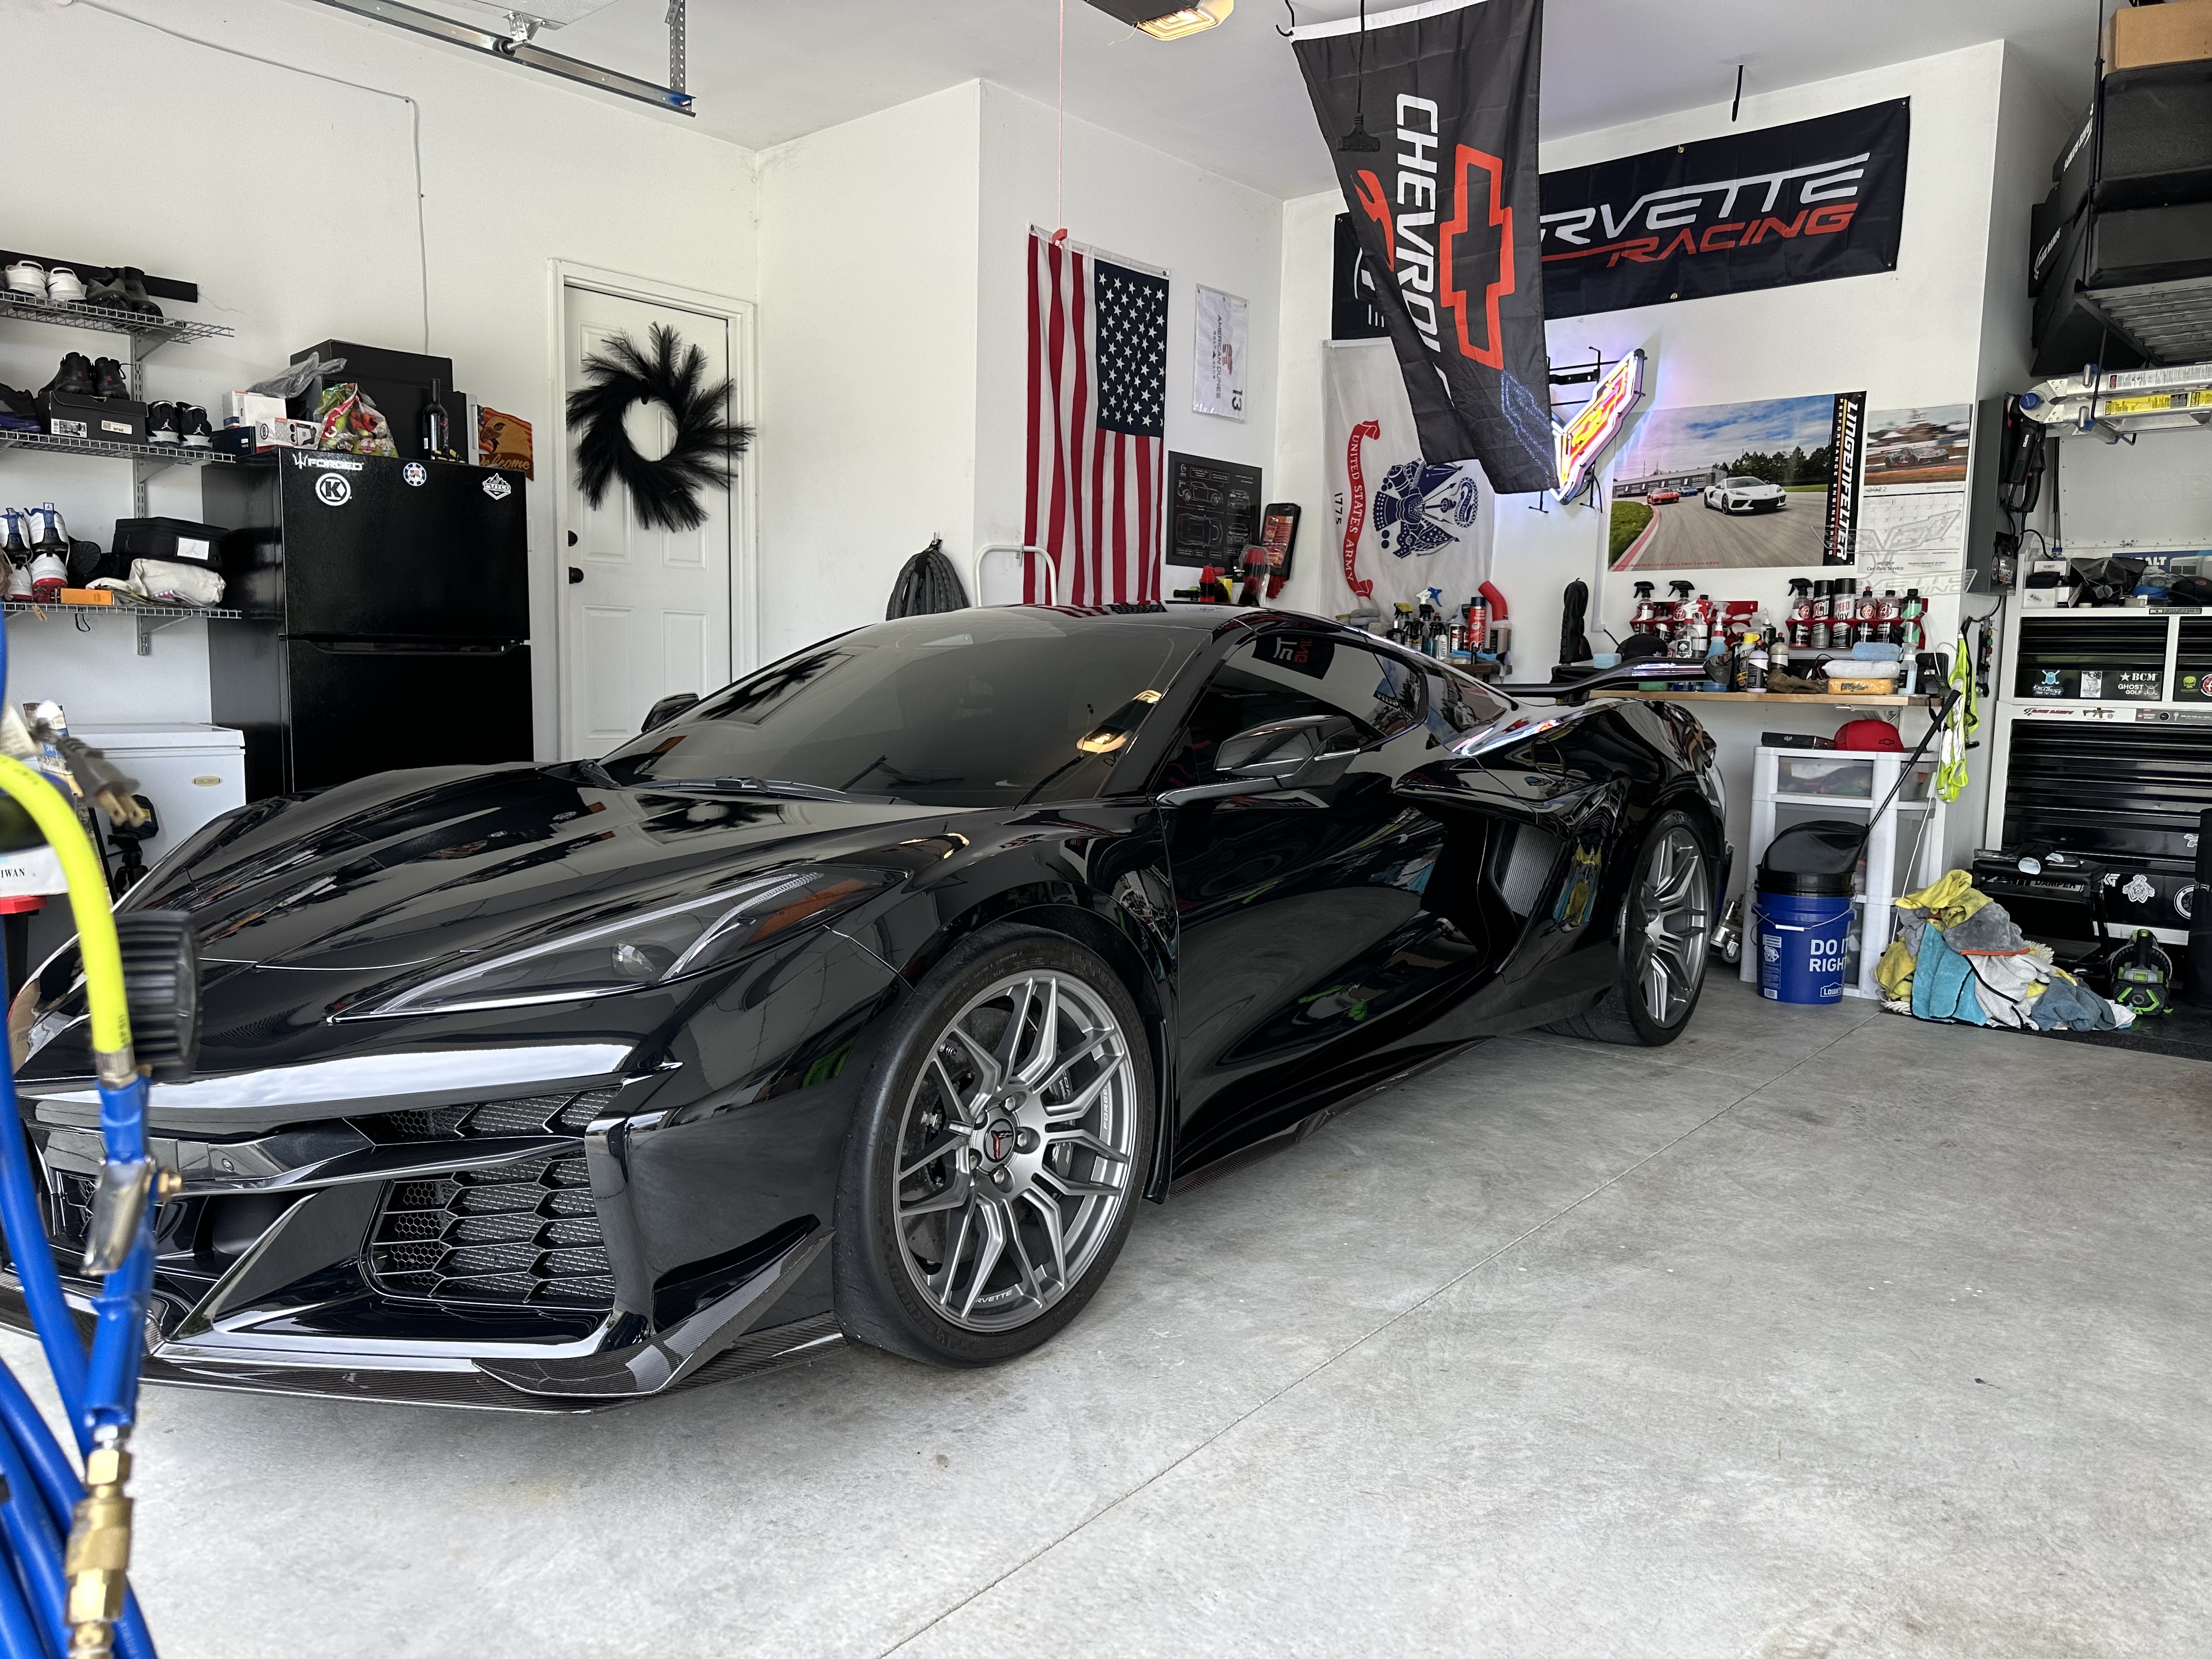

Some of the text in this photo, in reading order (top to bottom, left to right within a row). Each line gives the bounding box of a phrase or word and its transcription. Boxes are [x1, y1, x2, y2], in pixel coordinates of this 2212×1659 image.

[1541, 152, 1870, 245] RVETTE
[1606, 202, 1859, 268] RACING
[1232, 390, 1243, 411] 13
[308, 459, 363, 471] FORGED
[1829, 398, 1844, 555] PERFORMANCE ENGINEERING
[1836, 400, 1859, 561] LINGENFELTER
[1334, 492, 1343, 525] 1775
[1345, 435, 1364, 582] UNITED STATES ARMY
[2135, 556, 2167, 566] ALT
[2131, 673, 2156, 681] BCM
[2033, 685, 2063, 694] EXCLUSIVE
[1810, 937, 1849, 956] DO IT
[1809, 956, 1848, 972] RIGHT
[1823, 987, 1842, 996] LOWE'S
[974, 1289, 1013, 1304] RVETTE
